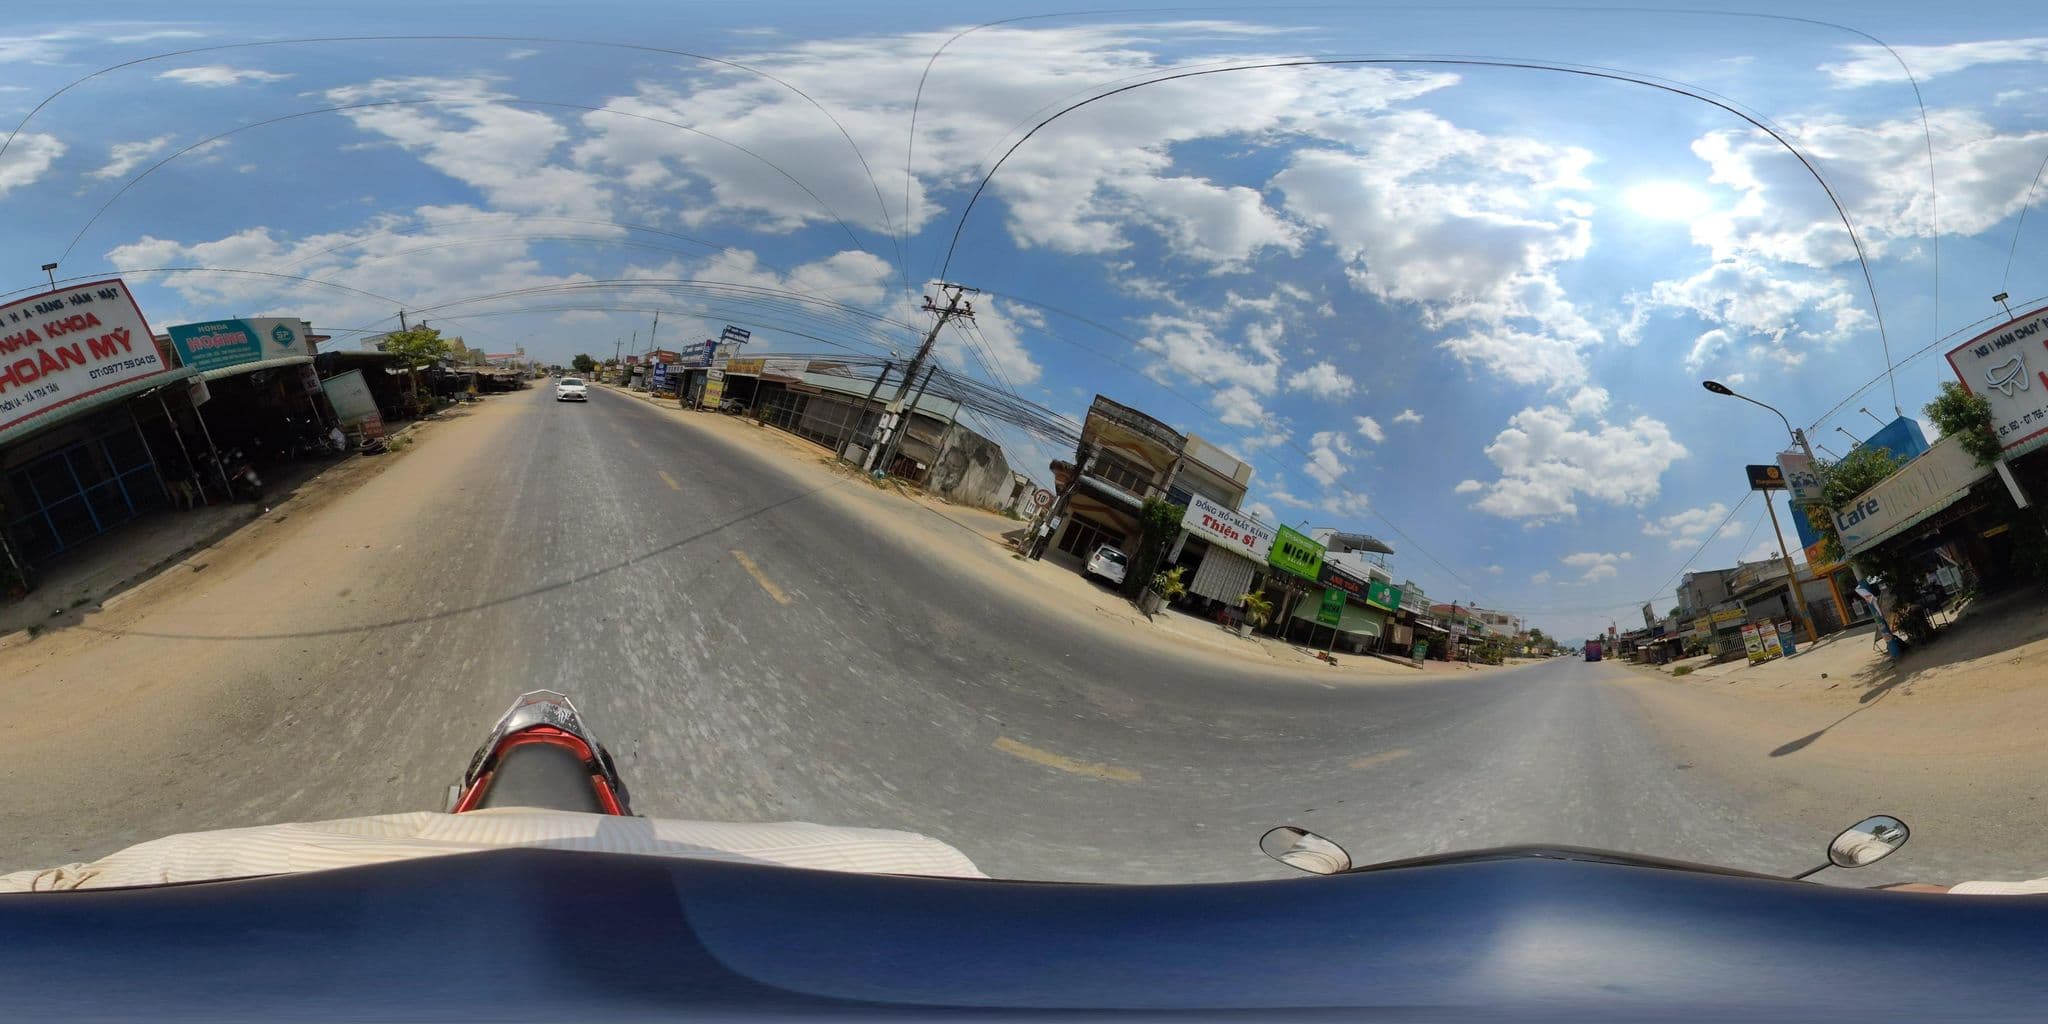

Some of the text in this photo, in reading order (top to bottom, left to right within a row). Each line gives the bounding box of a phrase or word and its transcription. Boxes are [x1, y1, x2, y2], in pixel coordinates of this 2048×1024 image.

[43, 311, 102, 339] KHOA
[86, 326, 133, 361] MỸ
[123, 359, 135, 369] 59
[134, 357, 146, 366] 04
[1202, 513, 1239, 541] Thiện
[1836, 496, 1880, 532] Café
[1250, 526, 1270, 540] KÍNH
